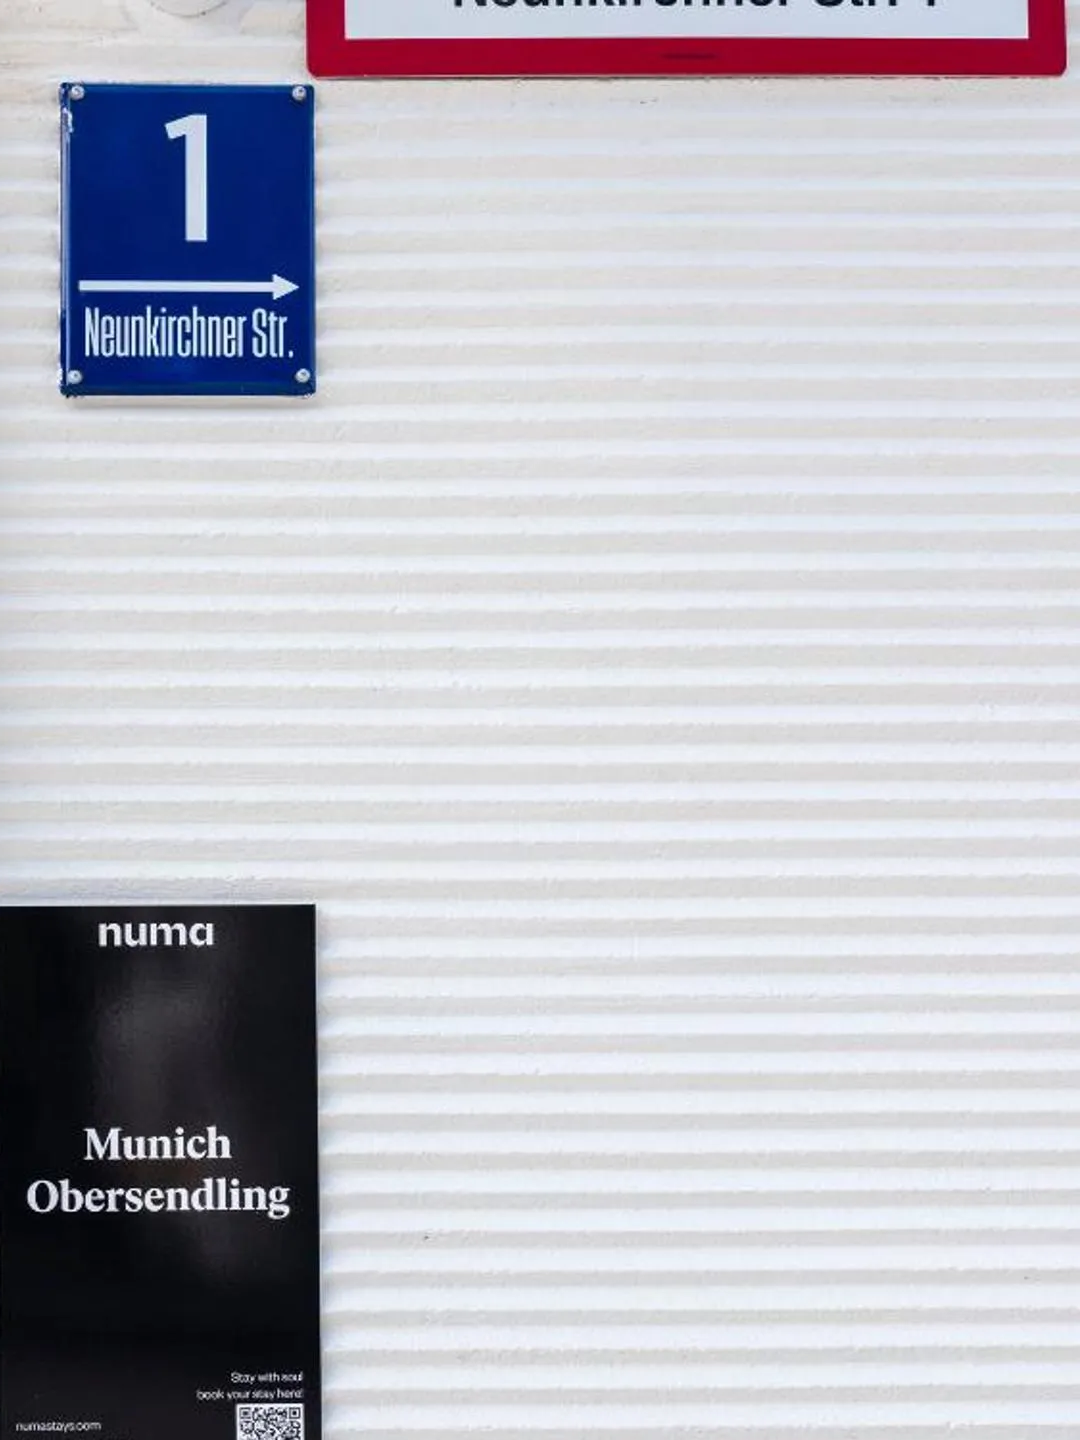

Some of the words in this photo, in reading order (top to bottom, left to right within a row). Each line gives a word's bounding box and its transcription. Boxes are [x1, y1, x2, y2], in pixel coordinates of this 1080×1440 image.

[165, 114, 207, 242] 1
[84, 305, 247, 358] Neunkirchner
[252, 308, 294, 358] Str.
[98, 922, 214, 947] numa
[83, 1126, 232, 1161] Munich
[26, 1177, 290, 1219] Obersendling
